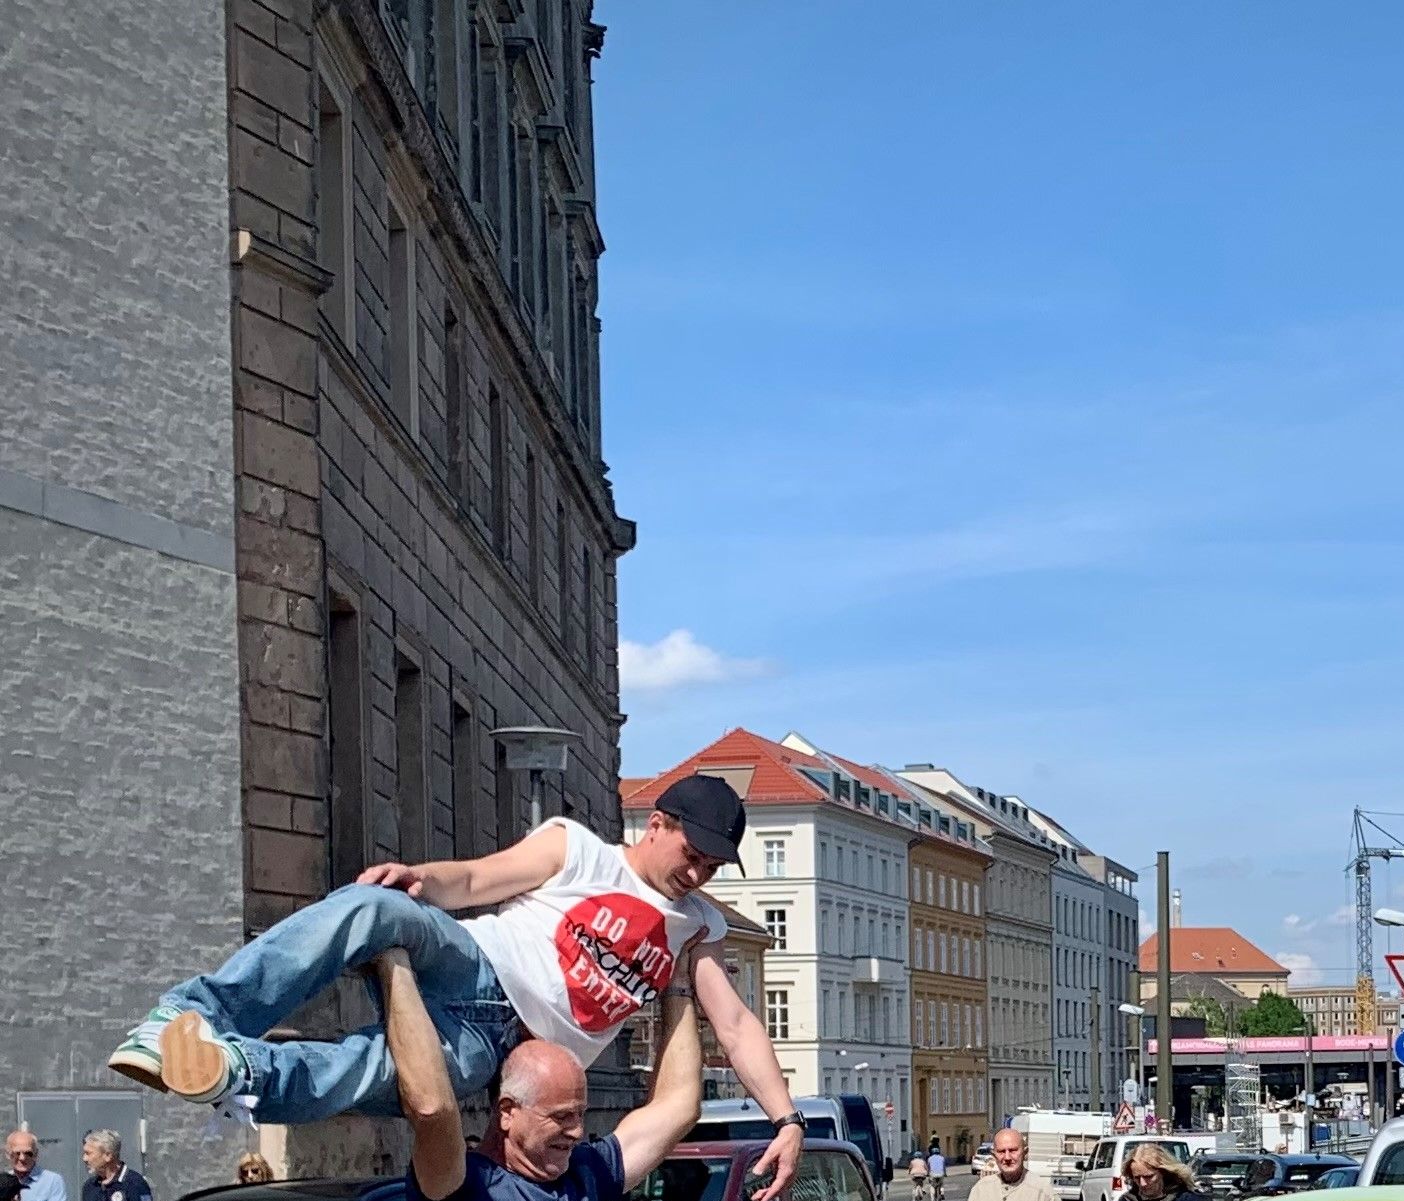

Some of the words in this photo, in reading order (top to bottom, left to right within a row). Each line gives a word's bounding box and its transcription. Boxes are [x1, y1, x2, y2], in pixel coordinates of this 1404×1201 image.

[591, 905, 628, 944] DO
[632, 937, 671, 979] NOT
[568, 955, 633, 1023] ENTER
